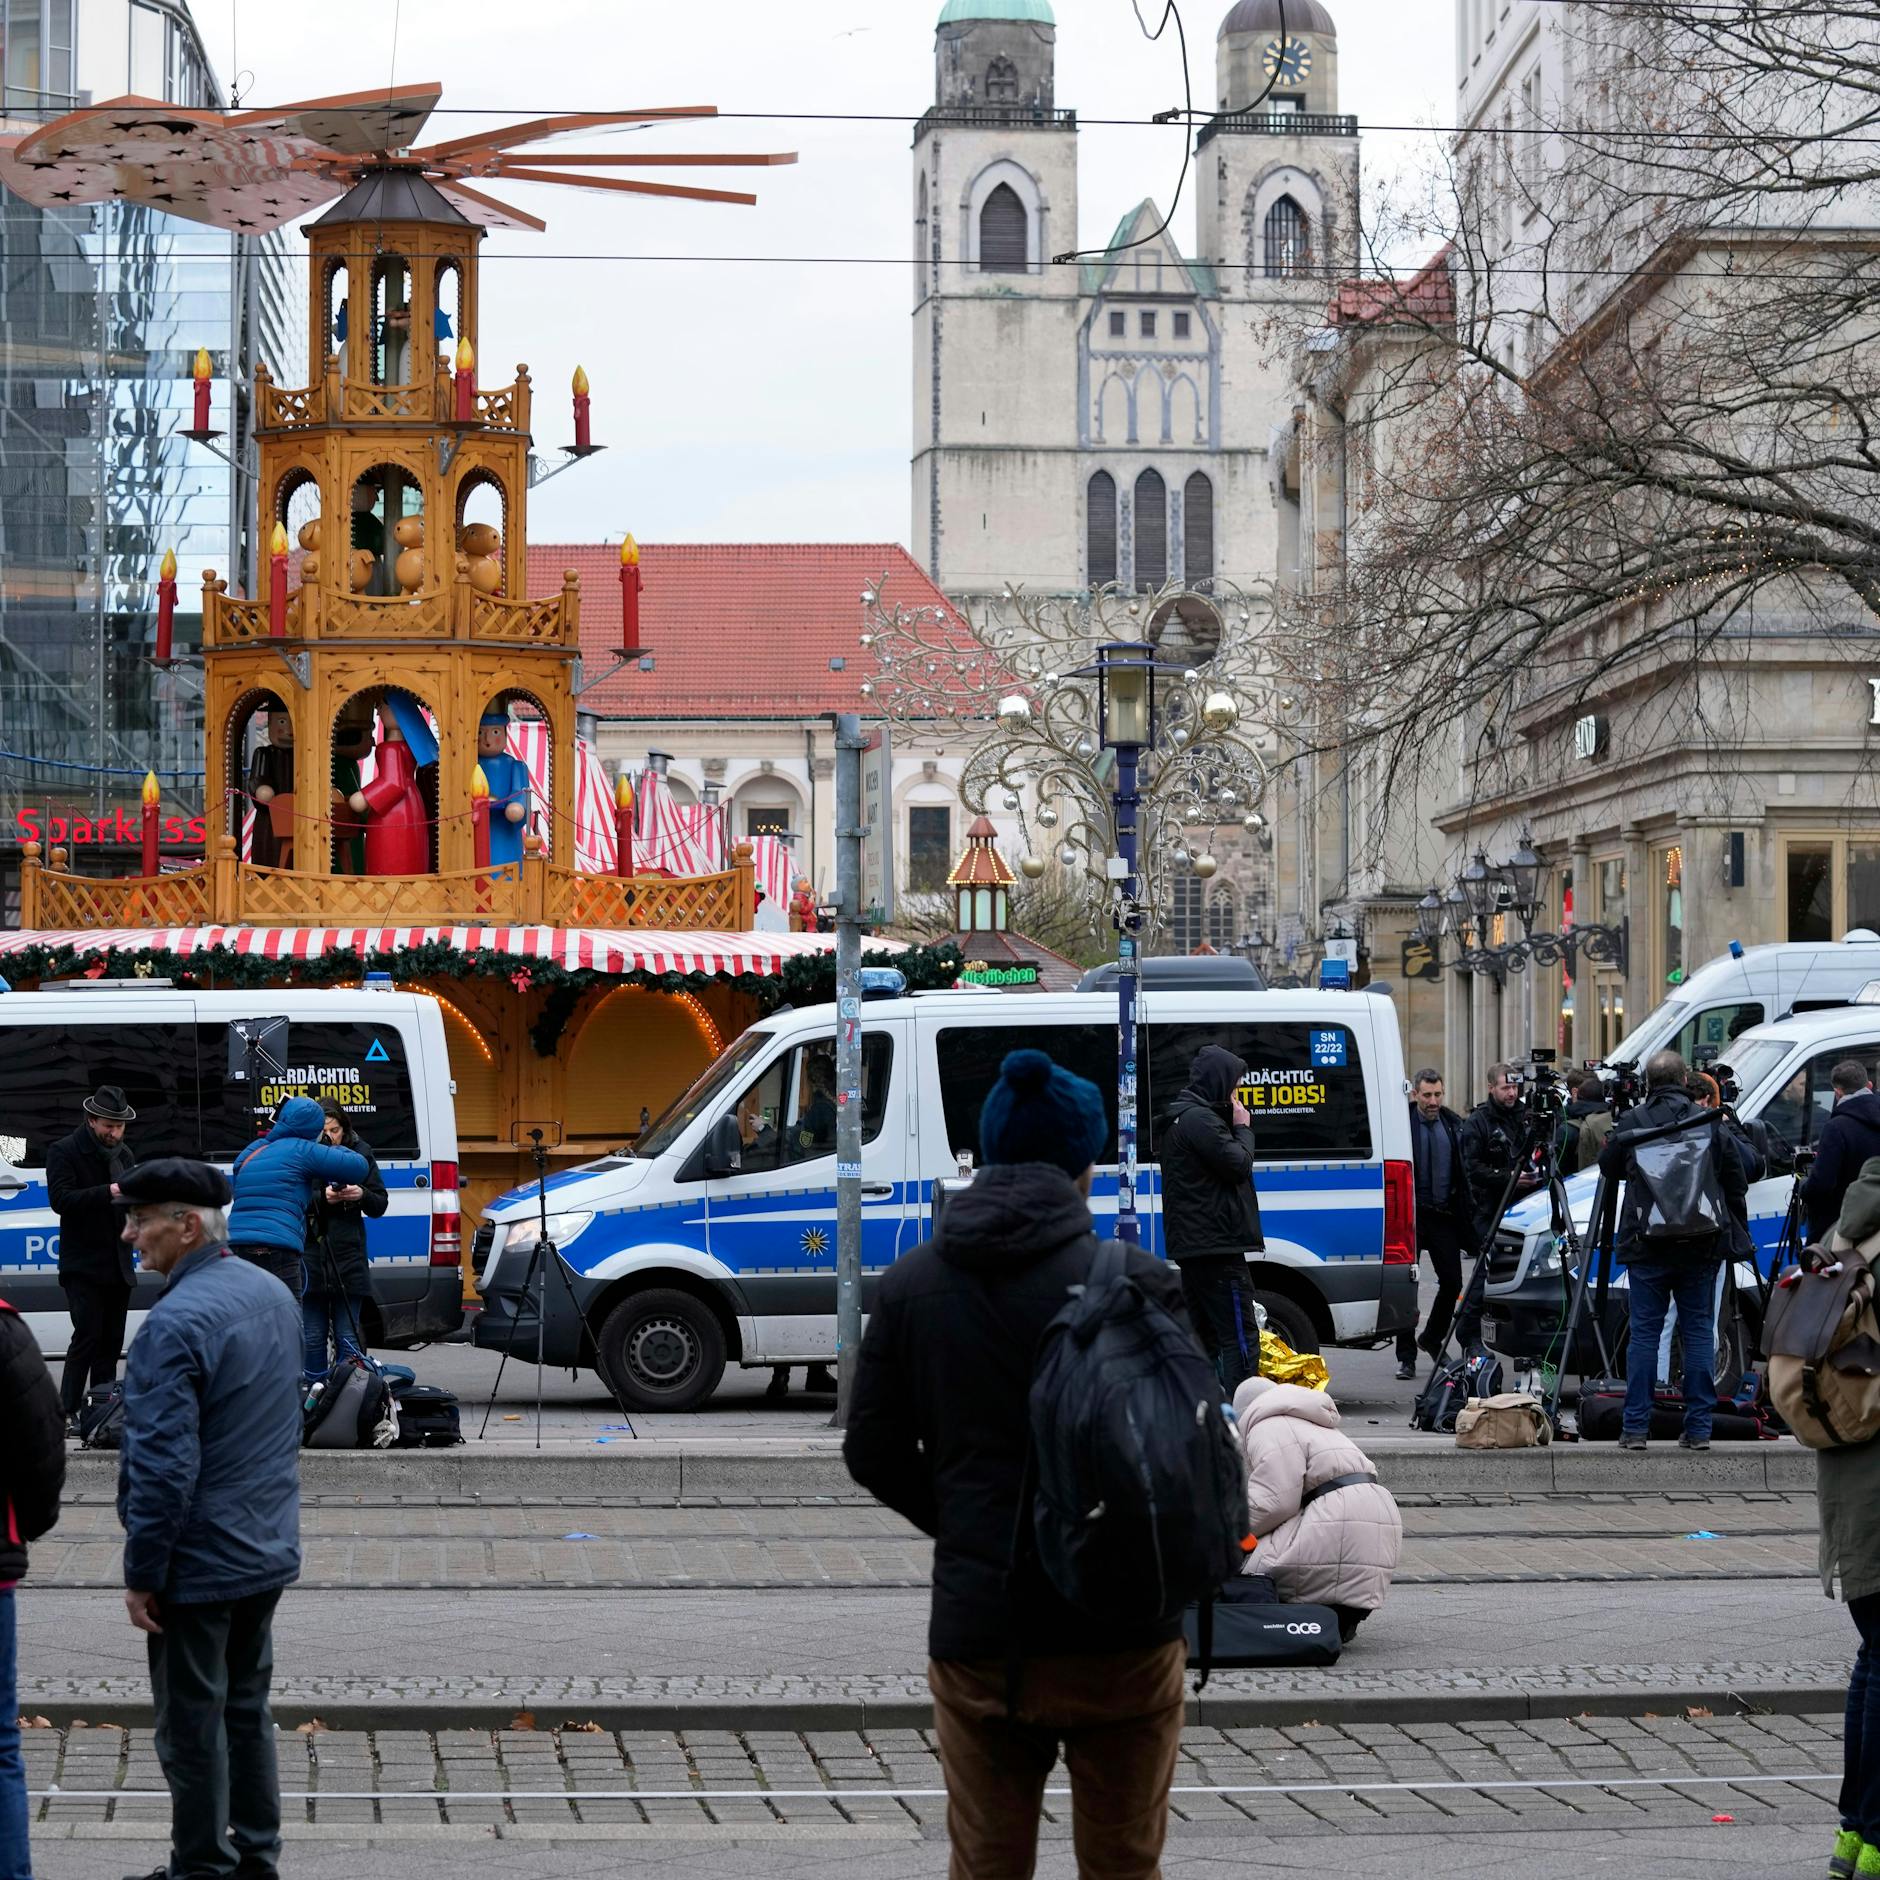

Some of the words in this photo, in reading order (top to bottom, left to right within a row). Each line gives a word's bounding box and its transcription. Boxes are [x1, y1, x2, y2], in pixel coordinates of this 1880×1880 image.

[1320, 1032, 1336, 1042] SN
[1314, 1043, 1342, 1053] 22/22
[1240, 1068, 1314, 1085] RDÄCHTIG
[315, 1085, 370, 1106] JOBS!
[1236, 1087, 1265, 1106] TE
[1270, 1084, 1326, 1107] JOBS!
[1287, 1622, 1322, 1634] ace
